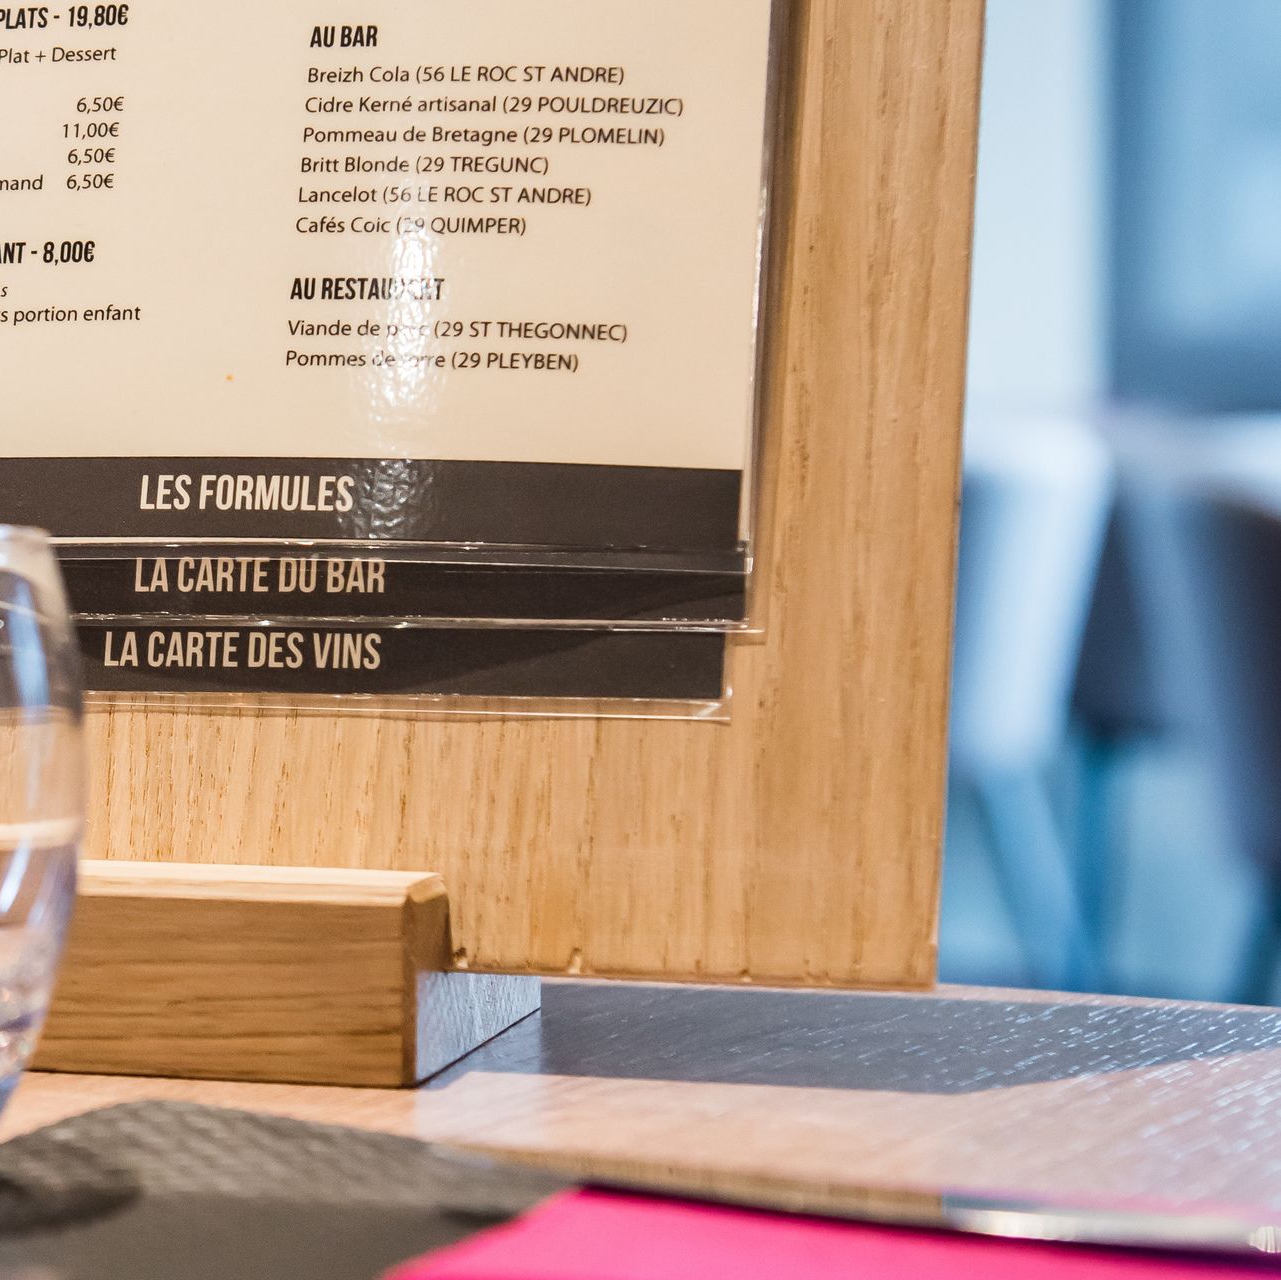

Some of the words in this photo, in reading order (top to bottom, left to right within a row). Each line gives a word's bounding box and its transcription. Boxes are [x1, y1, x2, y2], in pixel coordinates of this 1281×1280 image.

[68, 4, 129, 30] 19,80€
[309, 26, 335, 48] AU
[340, 25, 378, 47] BAR
[51, 46, 117, 63] Dessert
[307, 66, 364, 83] Breizh
[369, 66, 410, 83] Cola
[415, 66, 445, 84] (56
[450, 66, 471, 82] LE
[477, 66, 517, 82] ROC
[523, 66, 546, 82] ST
[550, 66, 625, 85] ANDRE)
[76, 96, 124, 114] 6,50€
[305, 96, 353, 113] Cidre
[359, 95, 412, 113] Kerné
[418, 96, 496, 113] artisanal
[502, 96, 532, 114] (29
[538, 96, 684, 117] POULDREUZIC)
[62, 122, 119, 140] 11,00€
[303, 127, 398, 143] Pommeau
[403, 126, 426, 143] de
[432, 126, 518, 147] Bretagne
[523, 127, 553, 145] (29
[558, 127, 665, 147] PLOMELIN)
[67, 148, 116, 165] 6,50€
[300, 157, 339, 173] Britt
[344, 156, 410, 173] Blonde
[415, 156, 446, 175] (29
[450, 157, 549, 175] TREGUNC)
[66, 173, 115, 190] 6,50€
[298, 186, 377, 203] Lancelot
[383, 186, 412, 205] (56
[418, 187, 438, 203] LE
[443, 186, 484, 204] ROC
[490, 187, 513, 203] ST
[517, 187, 592, 206] ANDRE)
[295, 216, 345, 234] Cafés
[430, 217, 526, 237] QUIMPER)
[43, 240, 96, 266] 8,00€
[290, 278, 317, 300] AU
[13, 306, 78, 325] portion
[83, 305, 141, 322] enfant
[288, 319, 352, 336] Viande
[357, 319, 381, 337] de
[434, 321, 463, 340] (29
[468, 321, 492, 338] ST
[496, 321, 628, 343] THEGONNEC)
[285, 350, 366, 367] Pommes
[451, 352, 481, 370] (29
[486, 353, 579, 372] PLEYBEN)
[140, 474, 192, 510] LES
[198, 475, 355, 512] FORMULES
[135, 557, 168, 593] LA
[177, 557, 269, 593] CARTE
[278, 558, 317, 593] DU
[326, 557, 385, 593] BAR
[104, 631, 139, 667] LA
[147, 631, 240, 668] CARTE
[247, 632, 304, 669] DES
[313, 633, 382, 669] VINS
